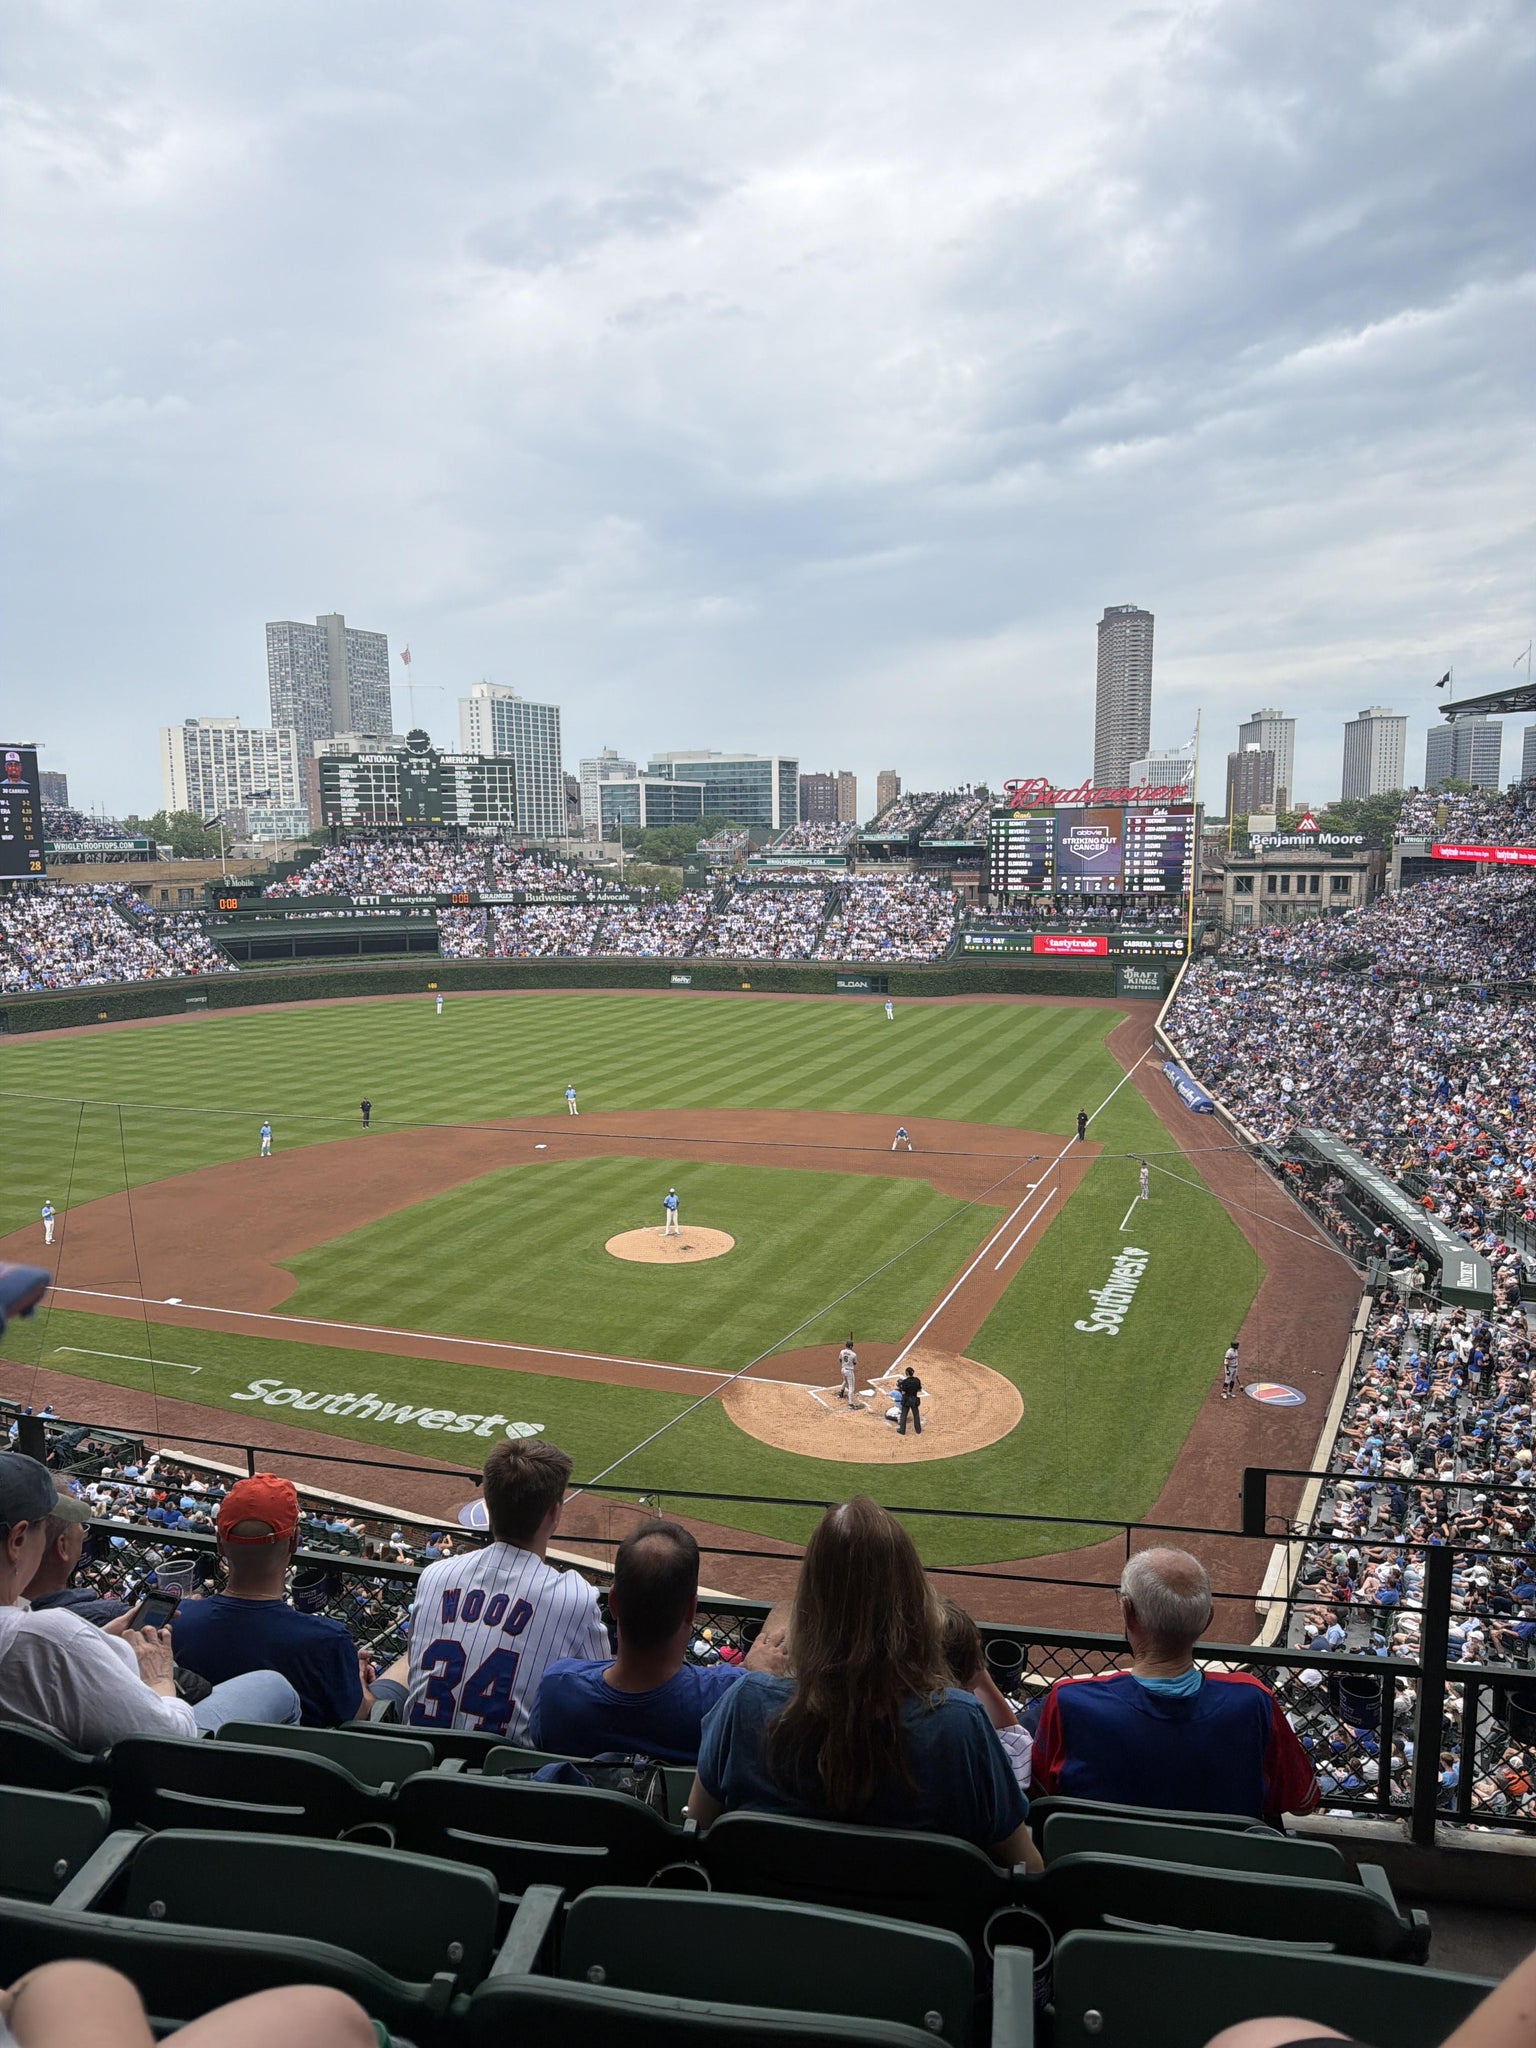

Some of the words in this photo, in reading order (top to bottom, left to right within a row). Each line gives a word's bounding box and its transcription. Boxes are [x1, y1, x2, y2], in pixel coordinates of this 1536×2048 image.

[358, 755, 399, 763] NATIONAL
[421, 776, 426, 784] 6
[1004, 777, 1188, 808] Budweiser
[1252, 834, 1314, 847] Benjamin
[1318, 833, 1363, 844] Moore
[54, 842, 134, 850] WRIGLEYROOFTOPS.COM
[30, 861, 41, 871] 28
[220, 899, 237, 910] 0:08
[350, 896, 380, 905] YETI
[1049, 939, 1097, 948] tastytrade
[1074, 1255, 1149, 1335] Southwest
[230, 1379, 509, 1437] Southwest
[442, 1588, 534, 1636] WOOD
[410, 1639, 520, 1736] 34
